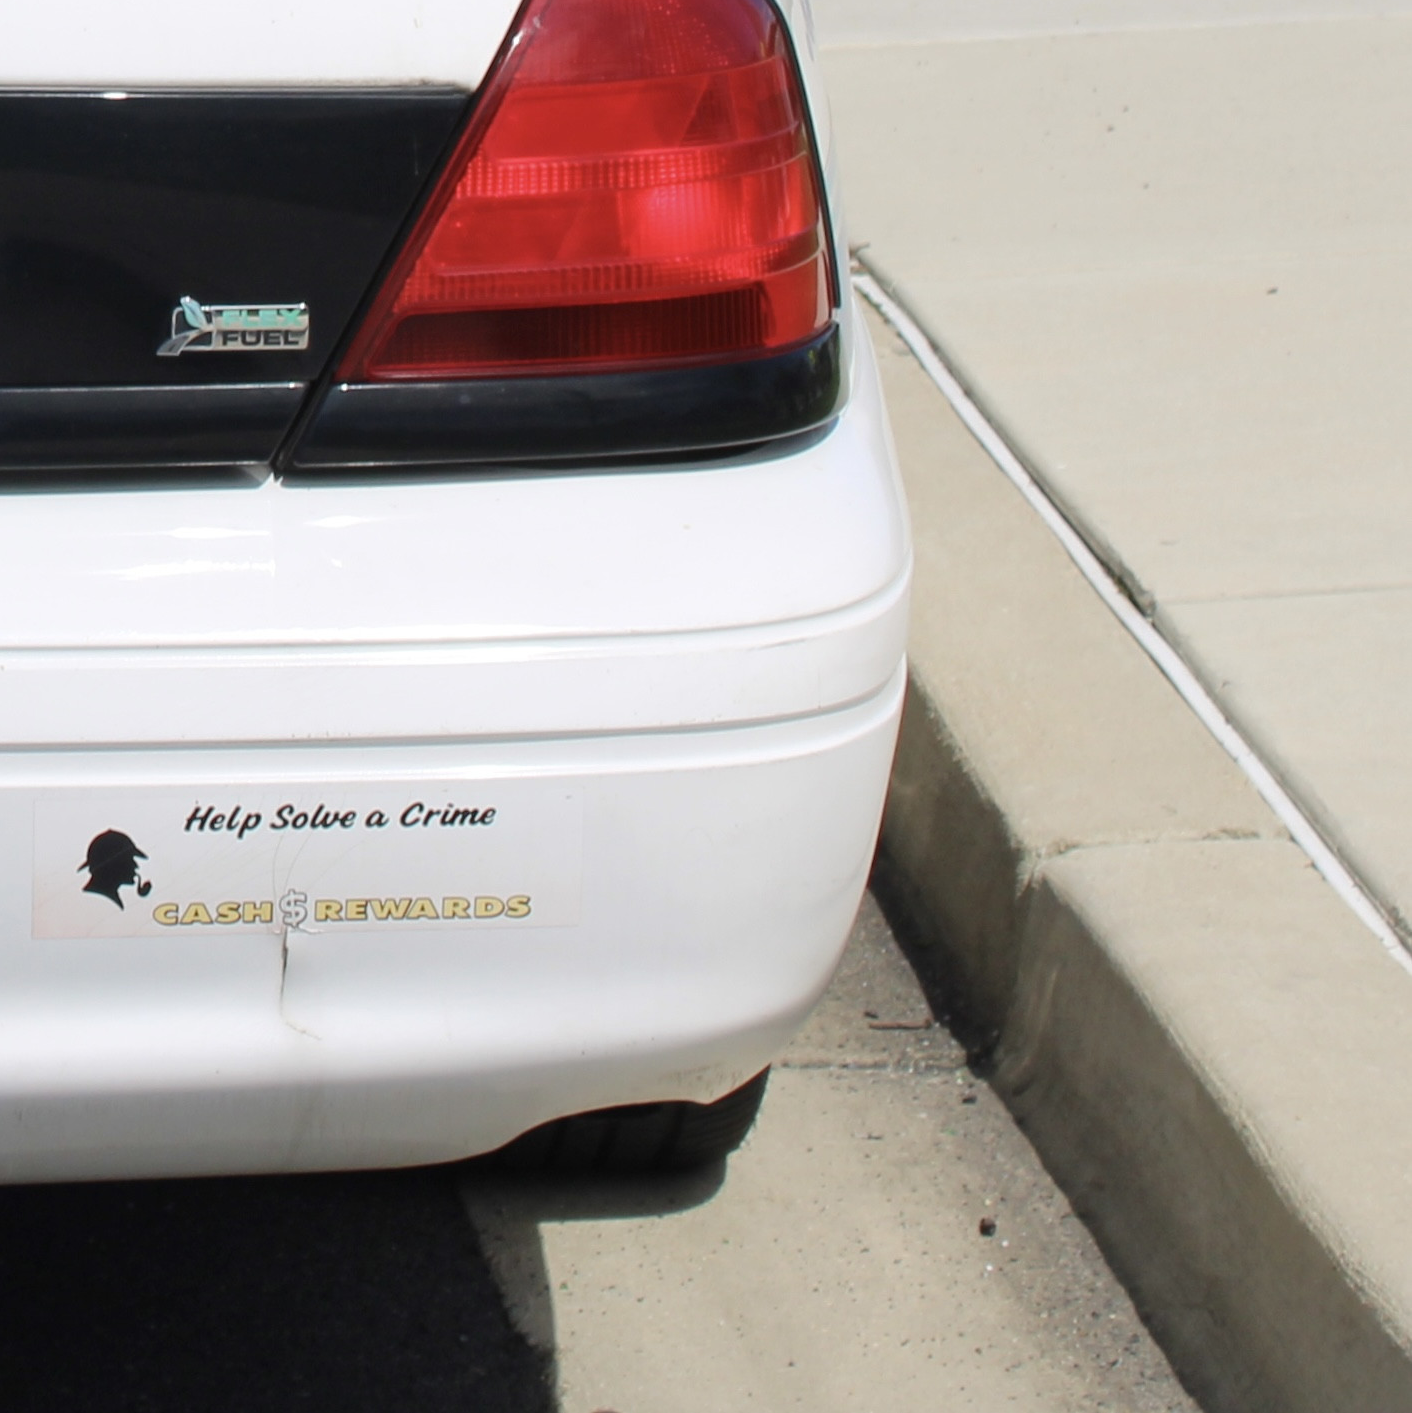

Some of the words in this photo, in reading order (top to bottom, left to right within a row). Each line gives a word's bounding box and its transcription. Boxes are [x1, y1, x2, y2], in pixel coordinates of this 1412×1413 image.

[222, 308, 304, 328] FLEX
[222, 330, 300, 346] FUEL
[184, 804, 262, 839] Help
[270, 803, 356, 830] Solve
[364, 809, 389, 827] a
[399, 802, 498, 828] Crime
[314, 895, 532, 921] REWARDS
